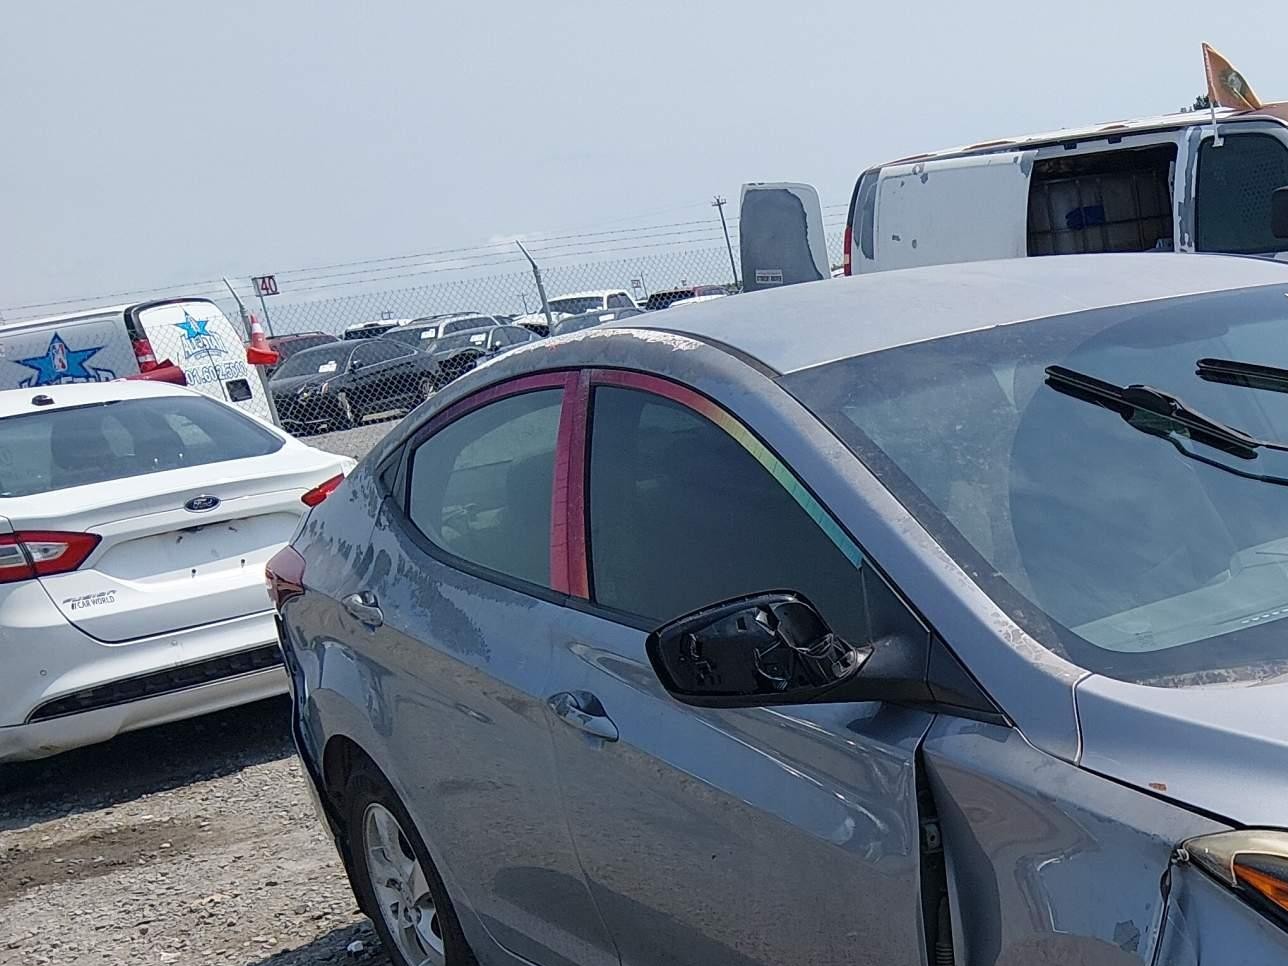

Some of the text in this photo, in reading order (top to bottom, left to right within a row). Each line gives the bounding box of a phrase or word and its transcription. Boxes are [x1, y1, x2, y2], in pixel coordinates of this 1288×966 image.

[261, 277, 278, 295] 40
[77, 599, 91, 609] CAR
[91, 595, 115, 606] WORLD
